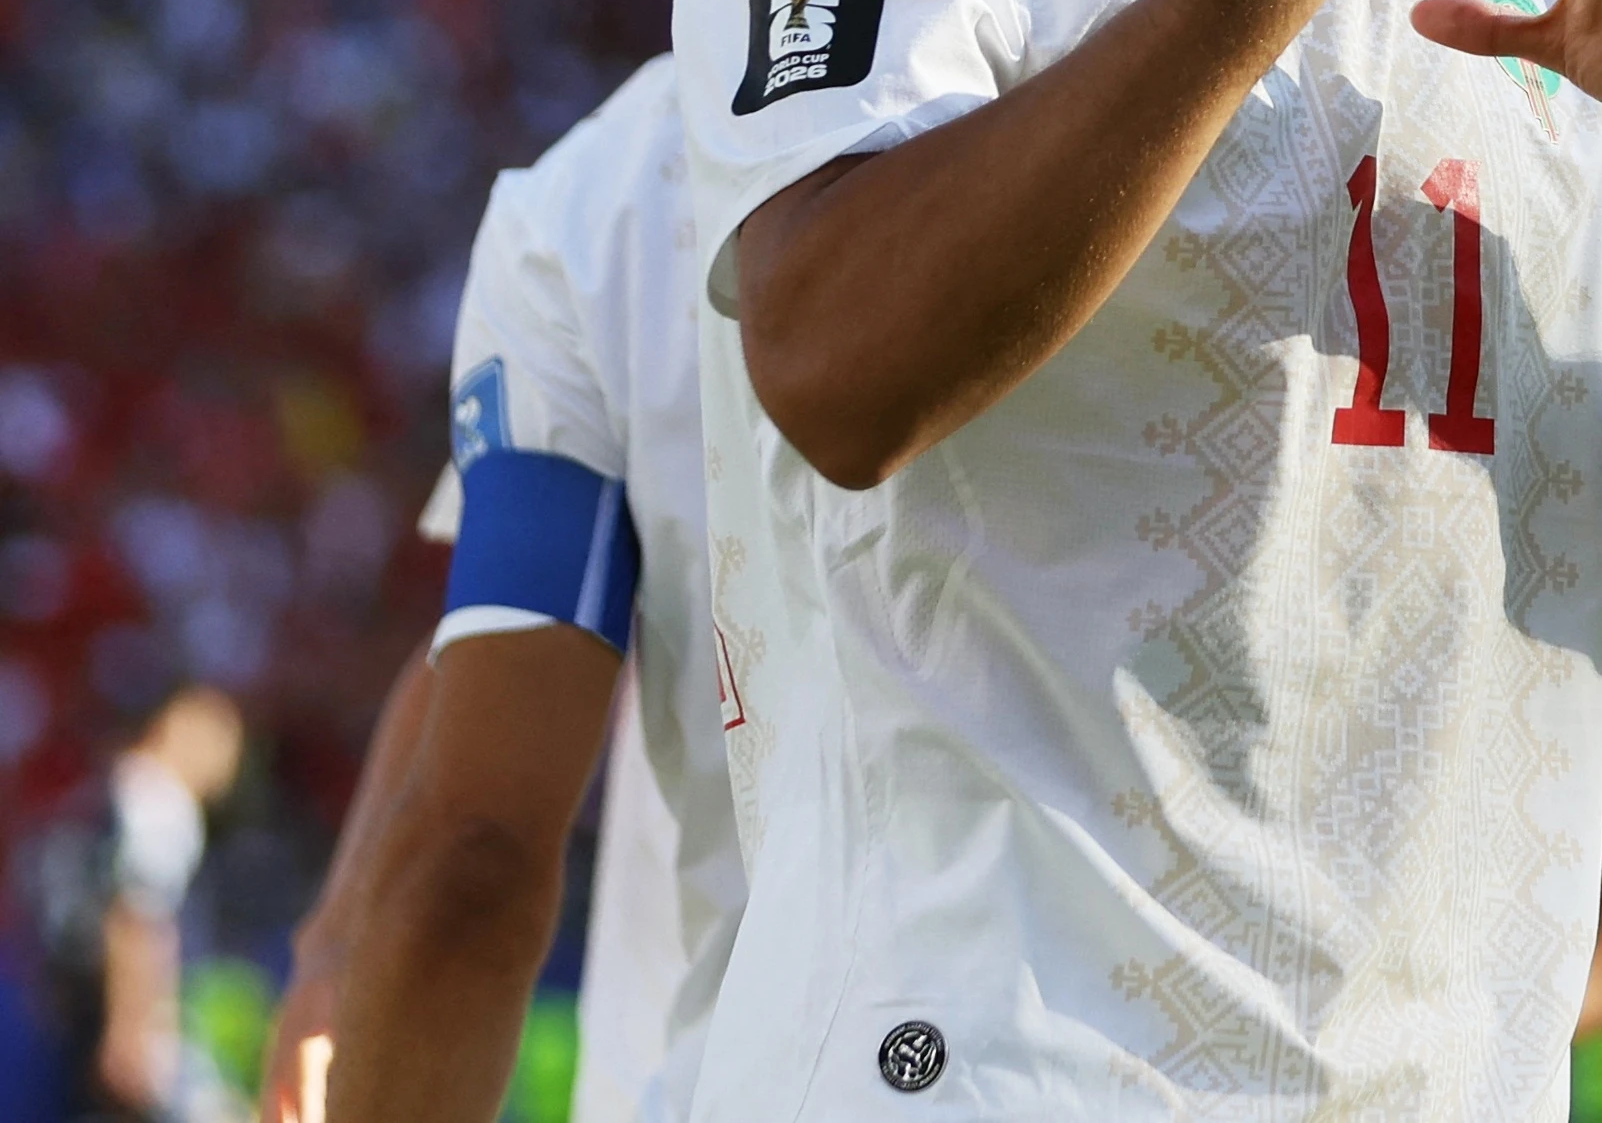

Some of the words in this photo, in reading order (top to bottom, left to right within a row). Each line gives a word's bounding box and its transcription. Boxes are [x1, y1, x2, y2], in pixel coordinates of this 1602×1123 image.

[781, 33, 811, 46] FIFA
[802, 54, 829, 63] CUP
[763, 65, 827, 96] 2026
[1331, 154, 1496, 455] 11
